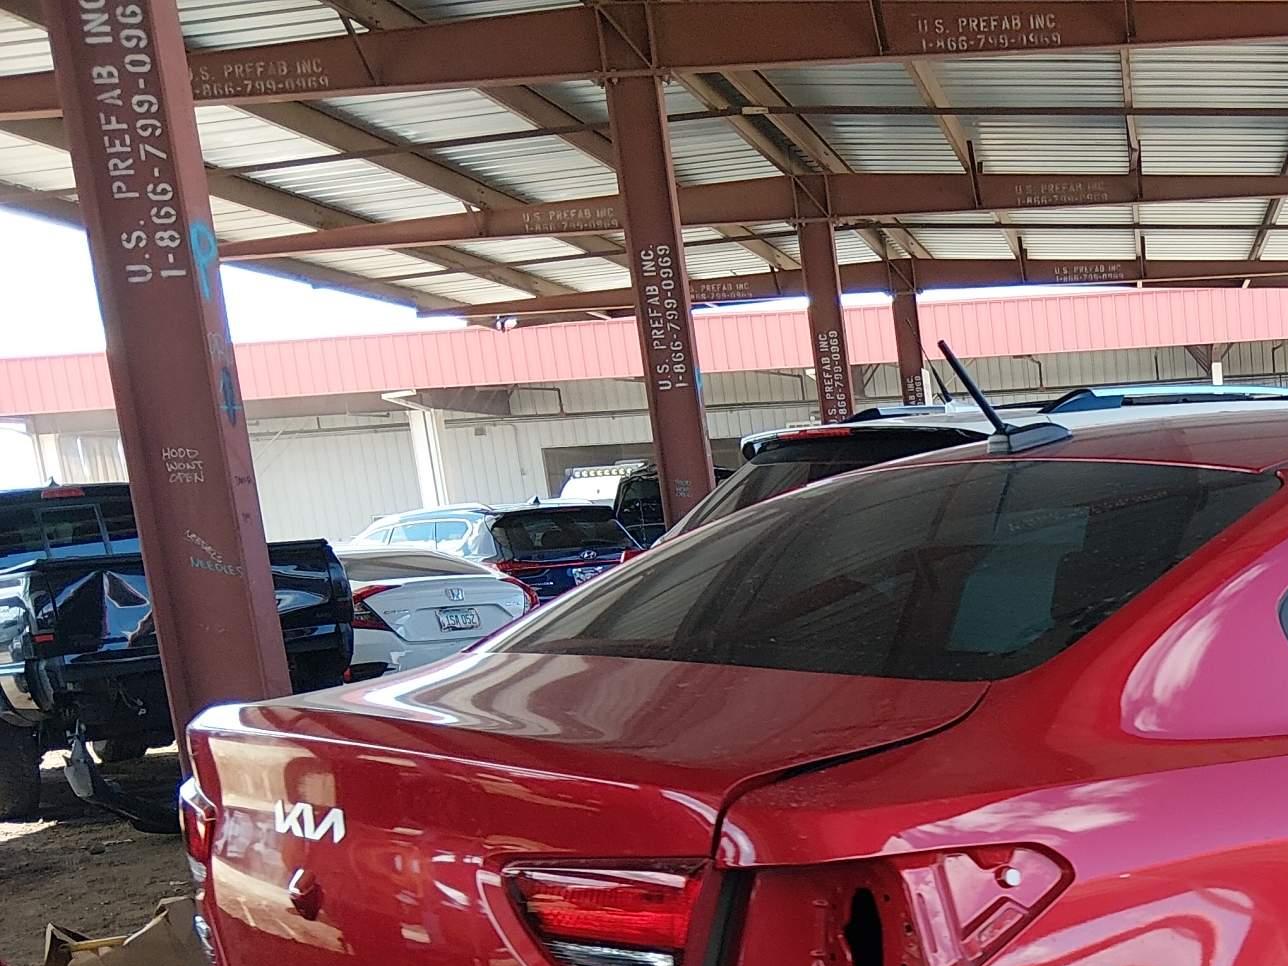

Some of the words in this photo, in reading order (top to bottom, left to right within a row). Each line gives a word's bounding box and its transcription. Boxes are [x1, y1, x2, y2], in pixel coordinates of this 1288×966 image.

[958, 14, 1021, 33] PREFAB
[223, 61, 288, 78] PREFAB
[92, 65, 140, 199] PREFAB
[121, 220, 153, 283] U.S.
[640, 244, 657, 277] INC.
[645, 285, 667, 350] PREFAB
[656, 245, 689, 388] 1-866-799-0969
[656, 359, 672, 390] U.S.
[821, 357, 835, 400] PREFAB
[168, 471, 205, 483] OPEN
[273, 799, 346, 844] KIA
